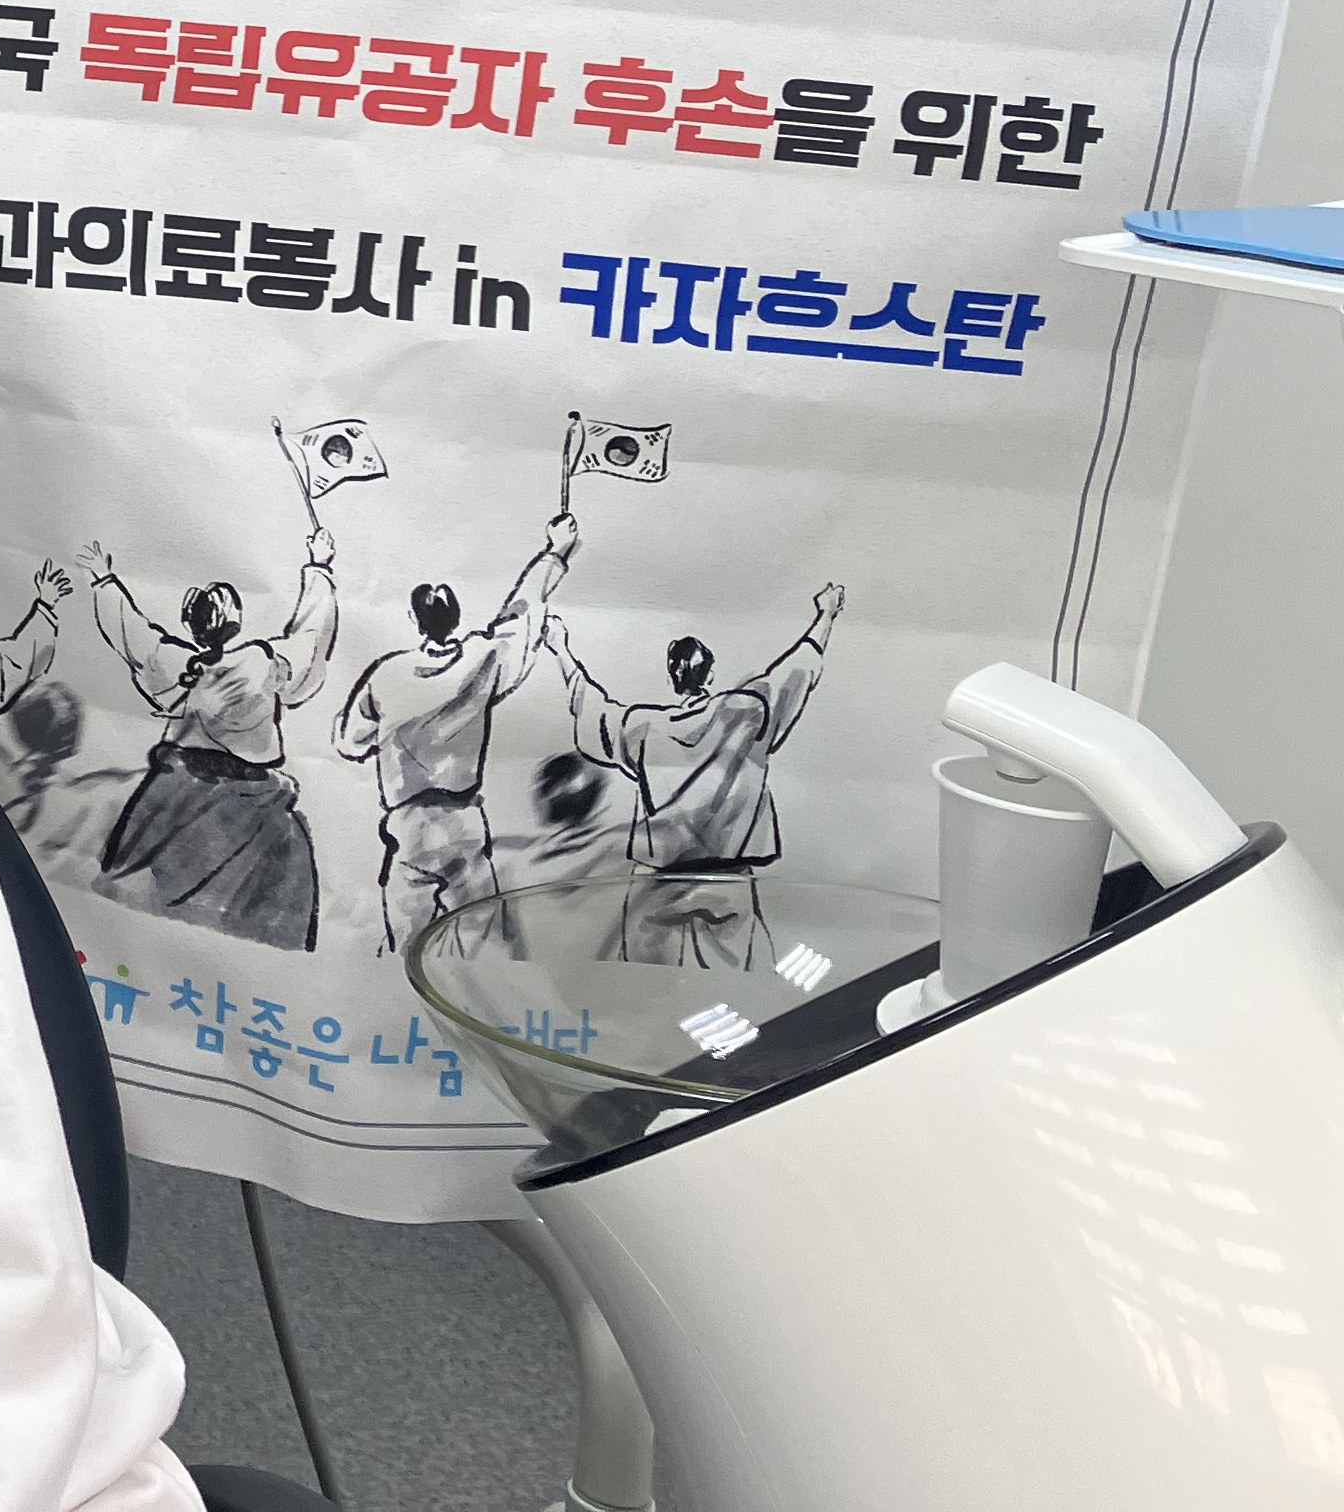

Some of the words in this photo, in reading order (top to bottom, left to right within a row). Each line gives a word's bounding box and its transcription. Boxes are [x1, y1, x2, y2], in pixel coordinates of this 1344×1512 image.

[80, 13, 555, 137] 독립유공자
[574, 57, 876, 169] 후손을
[892, 90, 1104, 190] 위한
[452, 244, 530, 332] in
[559, 252, 1046, 376] 카자흐스탄
